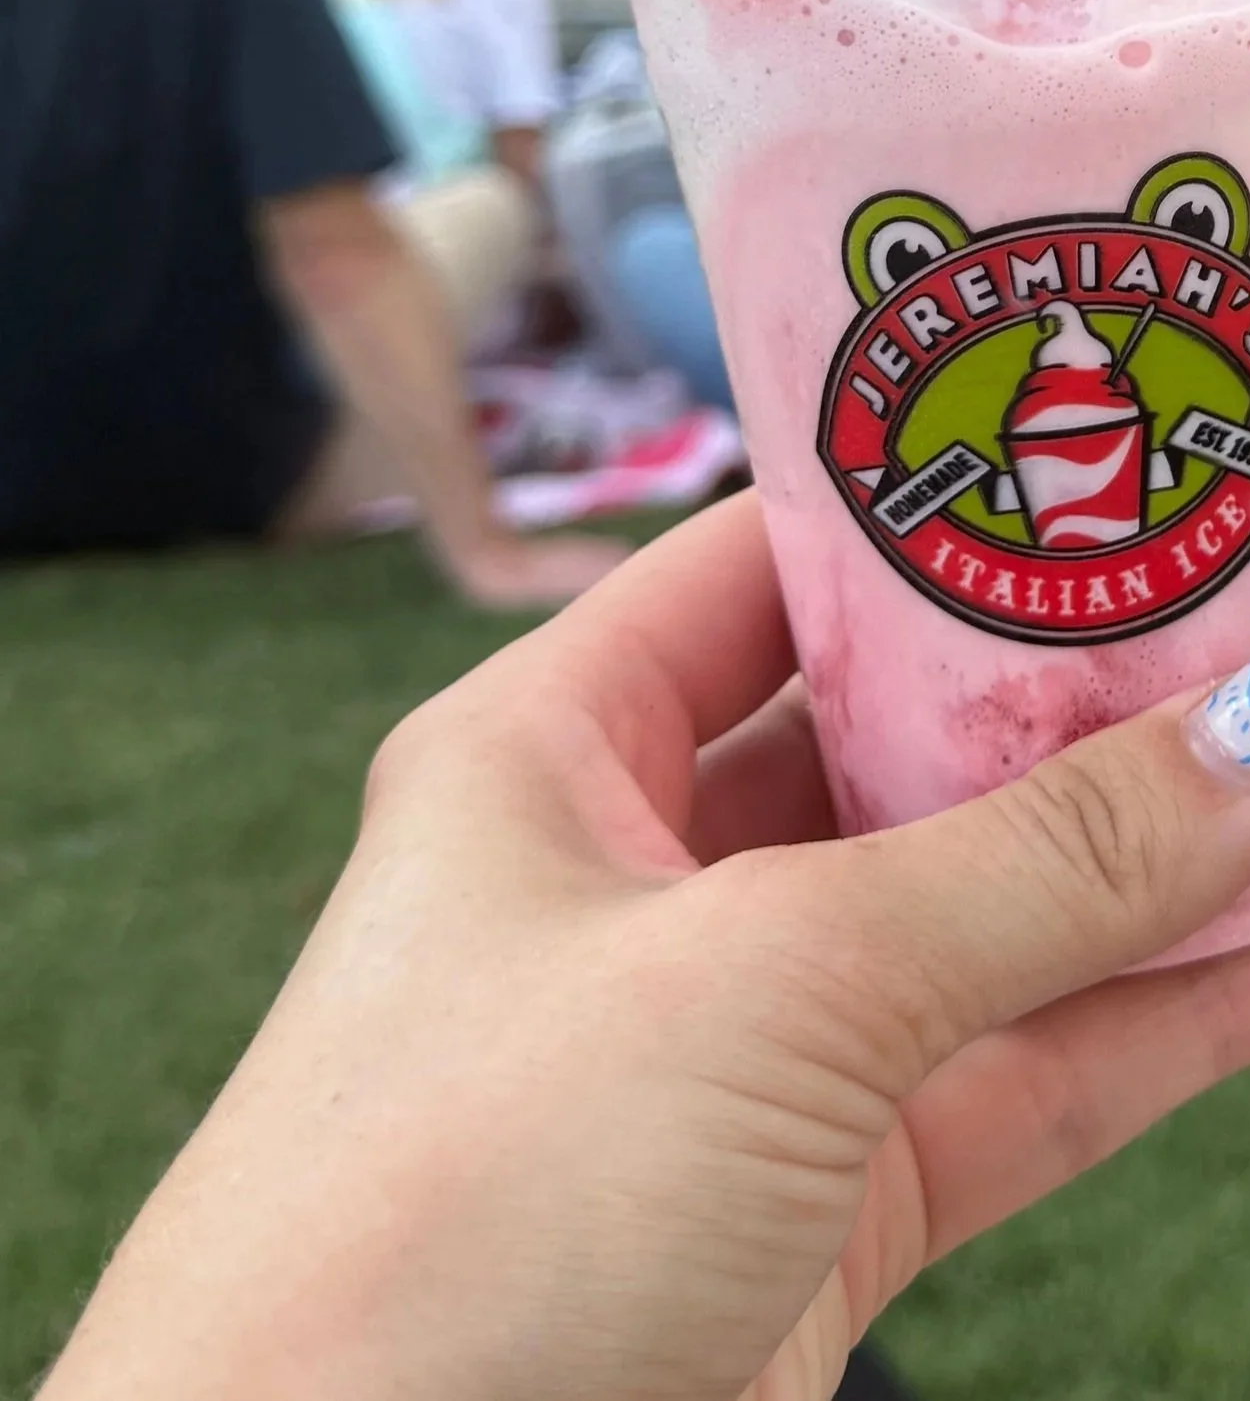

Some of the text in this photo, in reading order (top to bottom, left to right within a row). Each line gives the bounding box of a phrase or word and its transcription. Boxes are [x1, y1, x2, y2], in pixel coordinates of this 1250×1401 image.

[883, 451, 982, 525] HOMEMADE
[929, 493, 1247, 616] ITALIAN ICE
